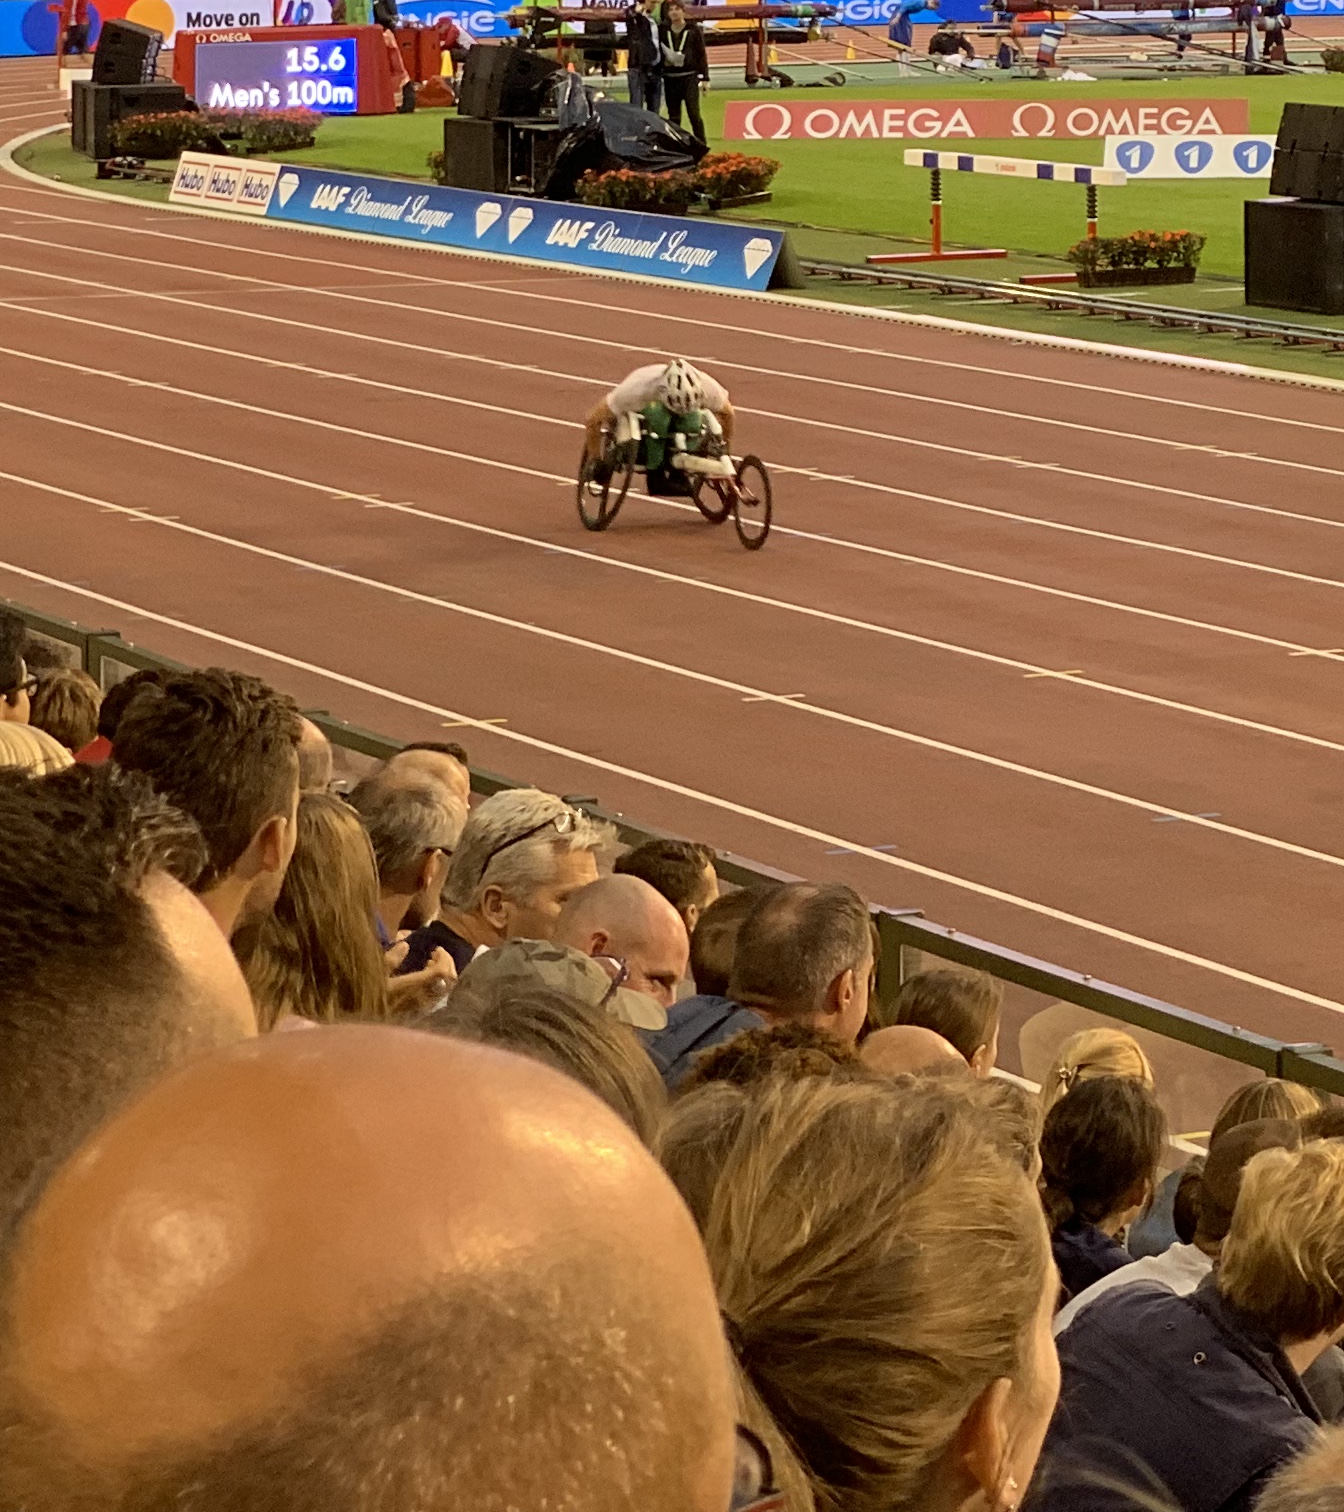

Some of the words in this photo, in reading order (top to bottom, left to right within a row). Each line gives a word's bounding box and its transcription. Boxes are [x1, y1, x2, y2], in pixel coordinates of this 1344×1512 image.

[186, 12, 234, 28] Move
[239, 12, 260, 26] on
[210, 33, 252, 43] OMEGA
[286, 46, 346, 73] 15.6
[209, 81, 280, 108] Men's
[287, 80, 354, 105] 100m
[804, 108, 975, 138] OMEGA
[1066, 106, 1223, 135] OMEGA
[178, 167, 205, 191] Hubo
[210, 172, 236, 195] Hubo
[242, 176, 269, 200] Hubo
[310, 183, 351, 211] IAAF
[347, 186, 406, 221] Diamond
[403, 195, 453, 234] League
[545, 218, 595, 248] IAAF
[588, 221, 660, 258] Diamond
[659, 230, 718, 274] League
